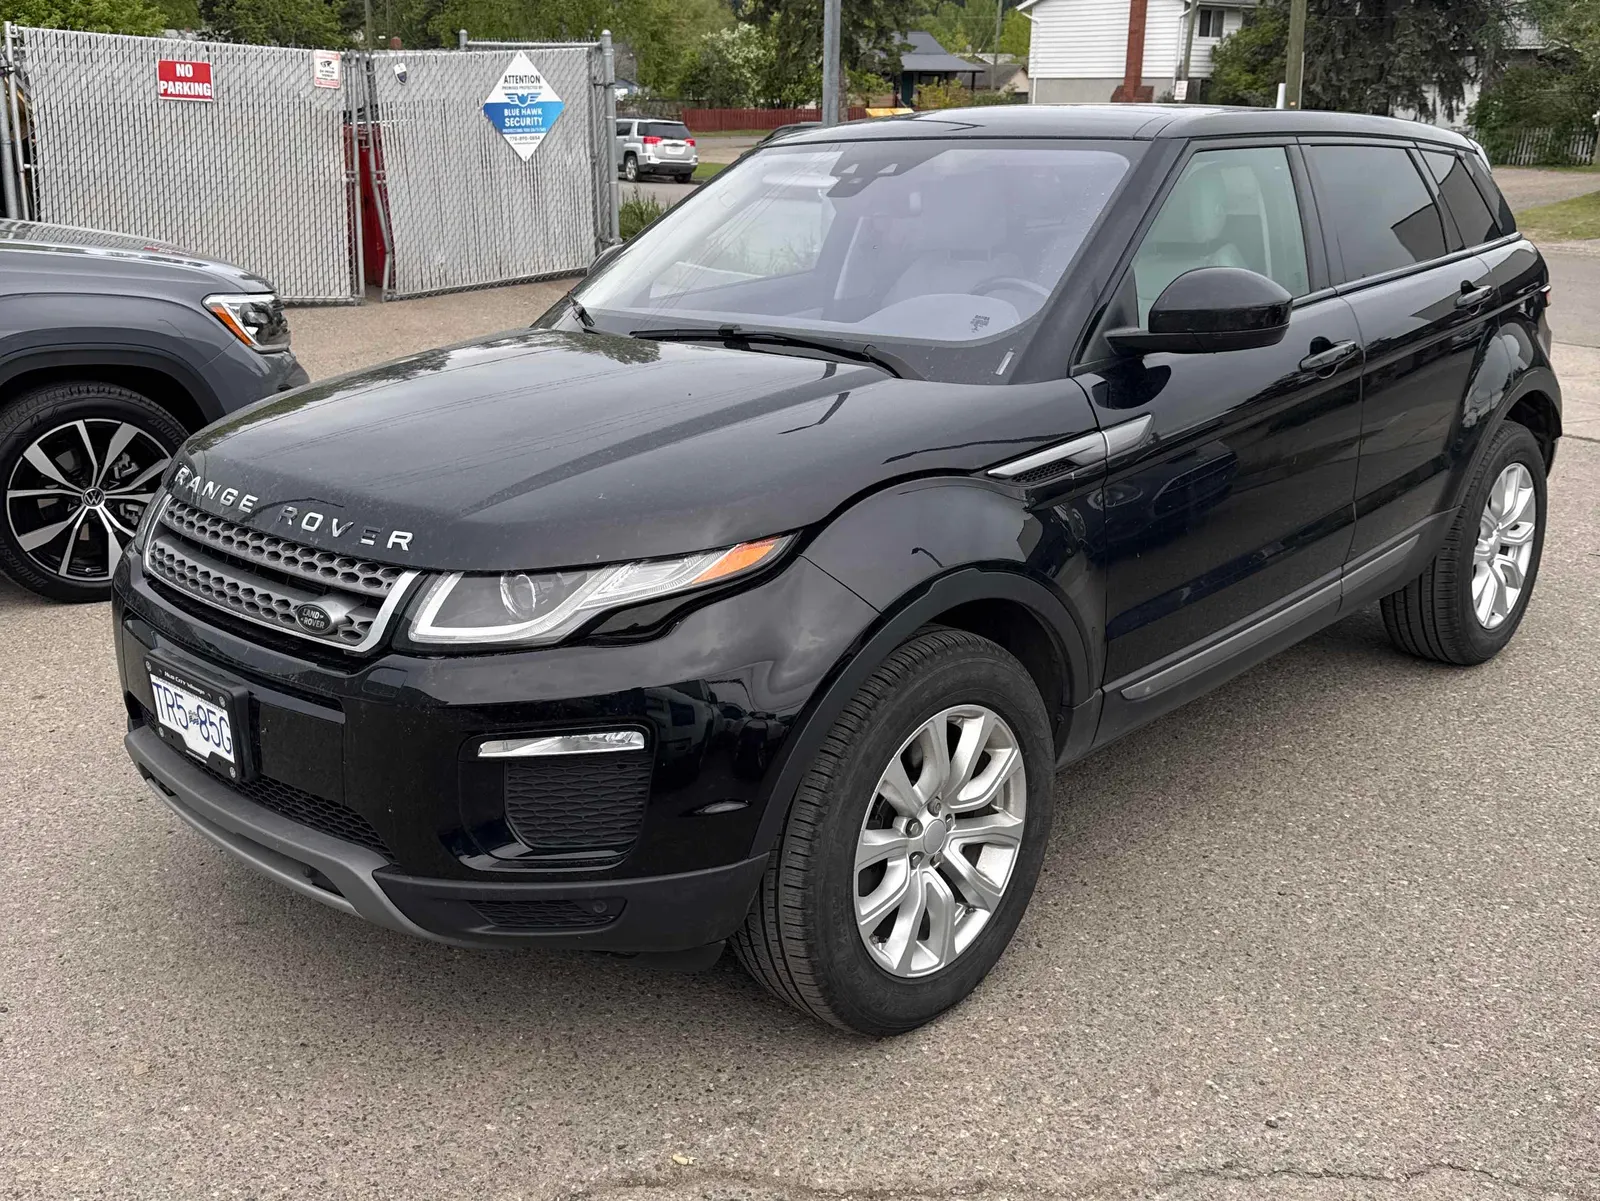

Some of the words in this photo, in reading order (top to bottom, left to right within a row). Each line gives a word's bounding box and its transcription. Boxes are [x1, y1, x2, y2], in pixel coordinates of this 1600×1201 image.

[175, 63, 194, 78] NO
[504, 75, 540, 84] ATTENTION
[159, 80, 212, 97] PARKING
[503, 108, 520, 116] BLUE
[521, 107, 543, 116] HAWK
[504, 117, 543, 127] SECURITY
[175, 466, 259, 513] RANGE
[276, 505, 414, 551] ROVER
[302, 608, 320, 620] LAND
[303, 616, 325, 629] ROVER
[152, 682, 189, 730] TR5
[196, 703, 233, 755] 85G
